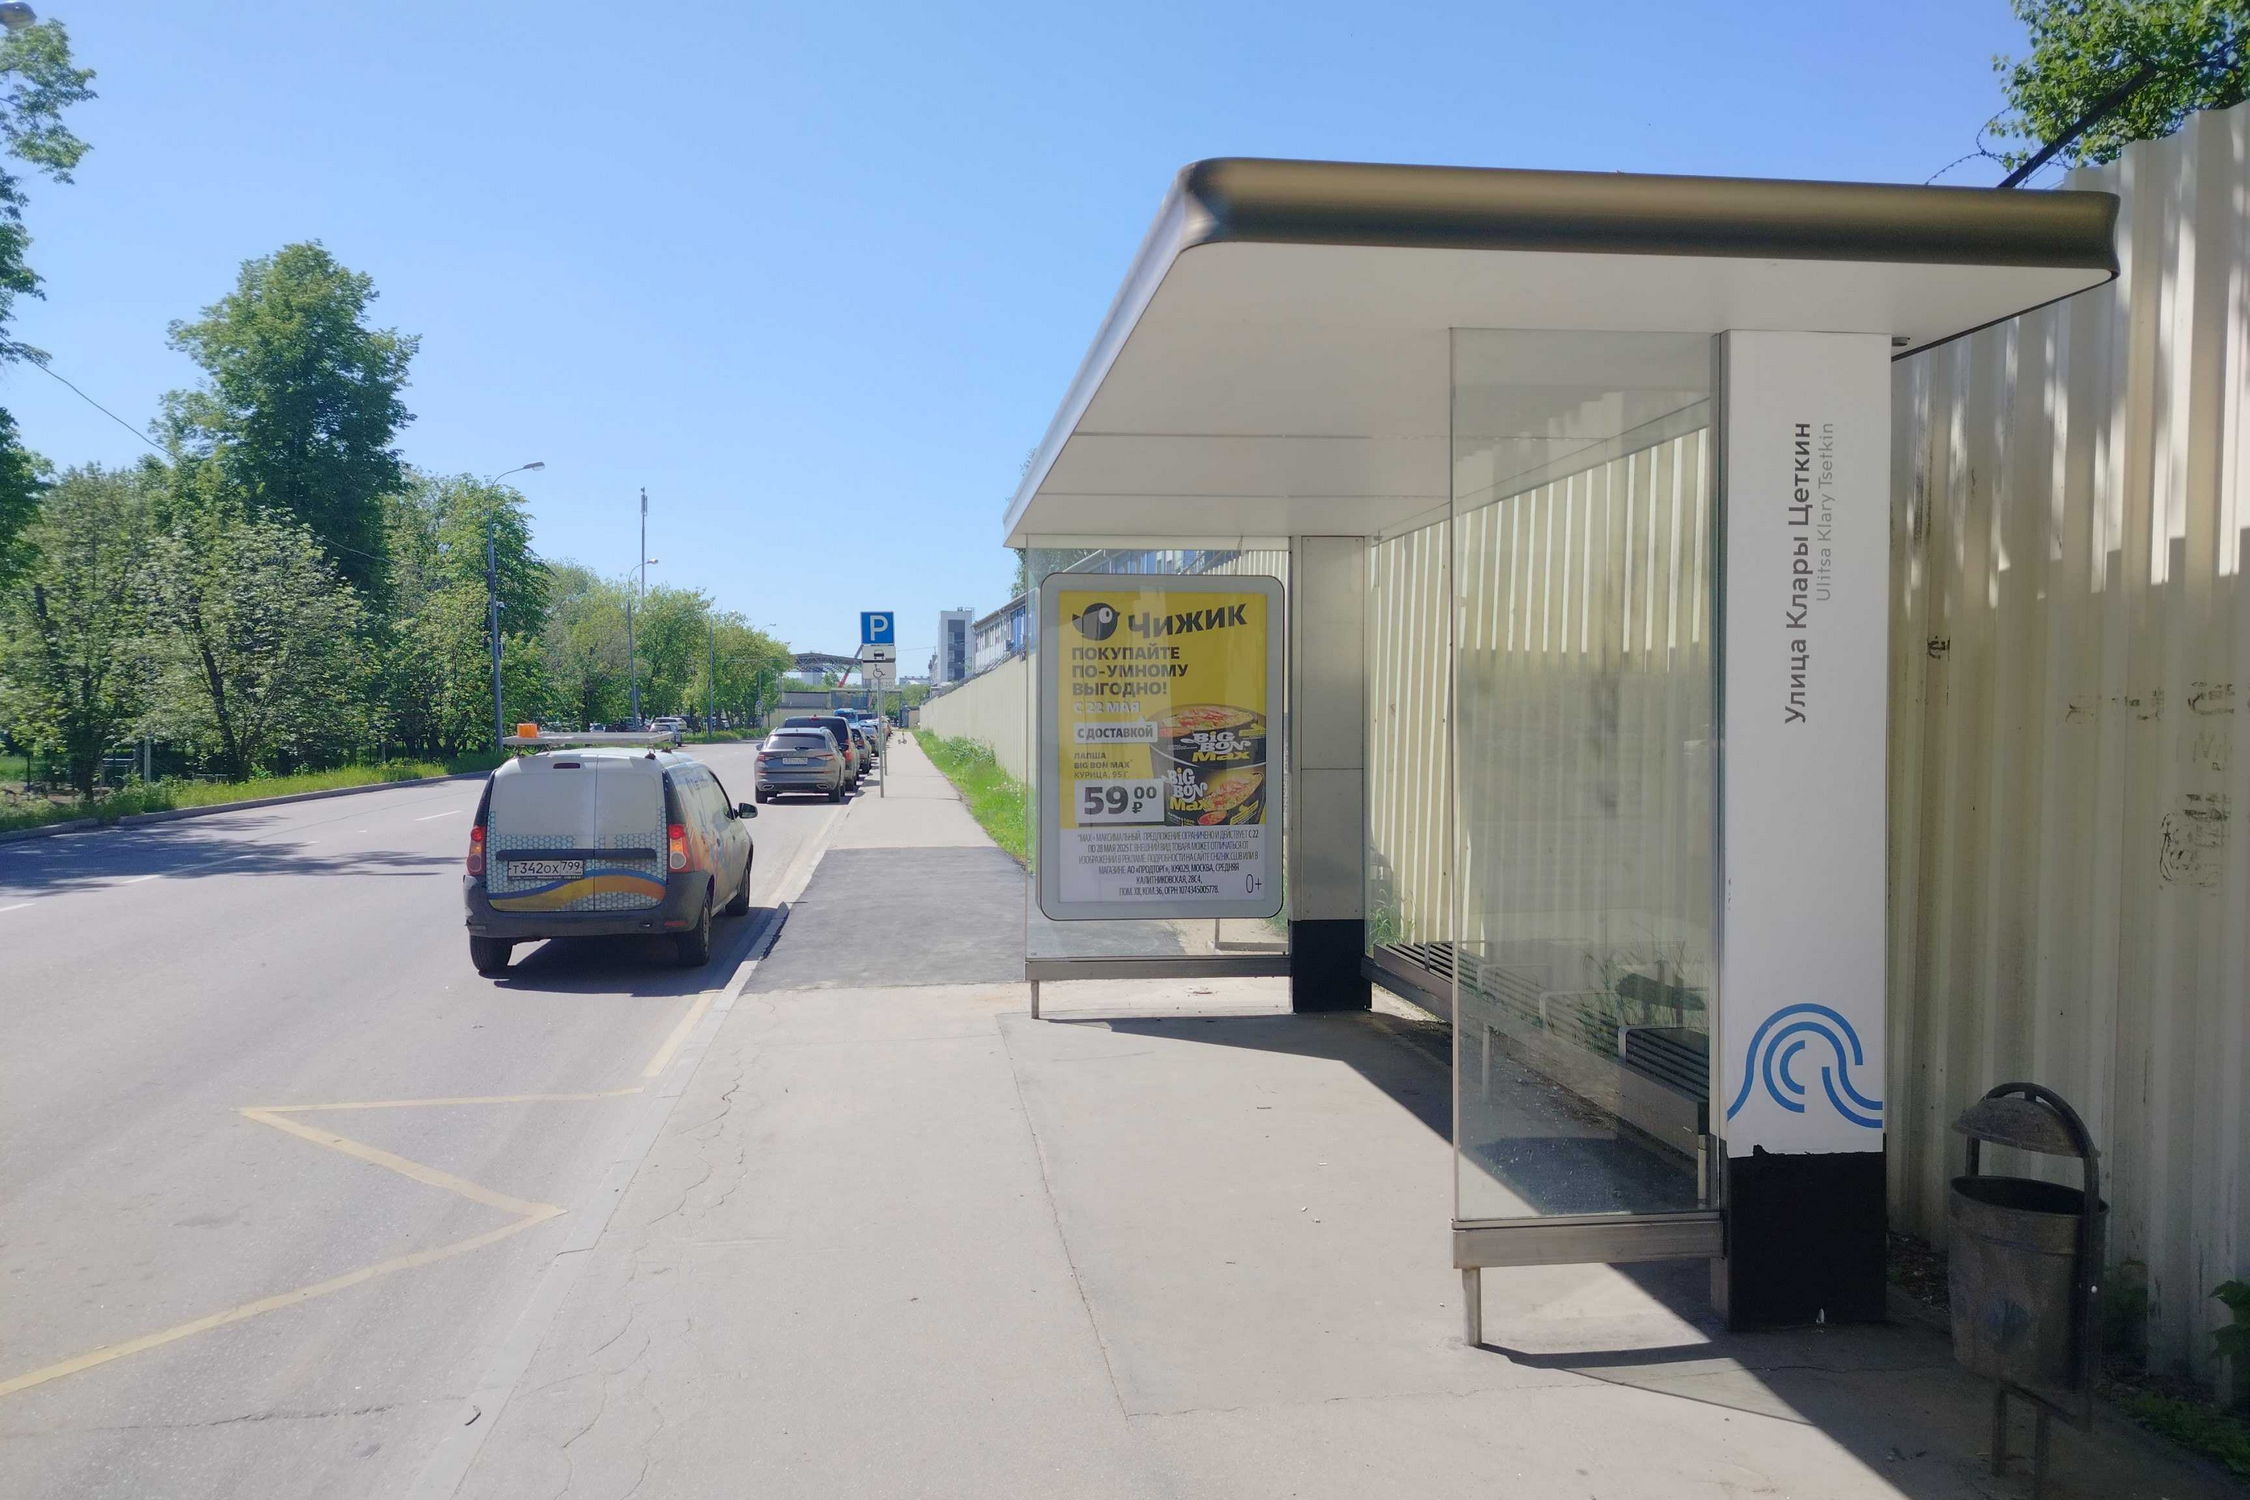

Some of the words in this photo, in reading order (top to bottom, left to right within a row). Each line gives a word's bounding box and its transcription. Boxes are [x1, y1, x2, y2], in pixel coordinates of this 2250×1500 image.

[1818, 423, 1833, 489] Tsetkin
[1788, 423, 1813, 525] Цеткин
[1817, 493, 1836, 541] Klary
[1786, 536, 1813, 628] Клары
[1816, 548, 1831, 601] Ulitsa
[1072, 643, 1180, 660] ПОКУПАЙТЕ
[1072, 664, 1188, 678] ПО-УМНОМУ
[1072, 682, 1168, 698] ВЫГОДНО!
[1785, 639, 1810, 724] Улица
[1087, 702, 1104, 713] 22
[1107, 701, 1141, 713] МАЯ
[1077, 728, 1085, 738] С
[1086, 724, 1154, 741] ДОСТАВКОЙ
[1074, 752, 1106, 760] ЛАПША
[1084, 786, 1129, 815] 59
[1253, 830, 1259, 838] 22
[1164, 886, 1178, 895] ОГРН
[1245, 873, 1262, 894] 0+
